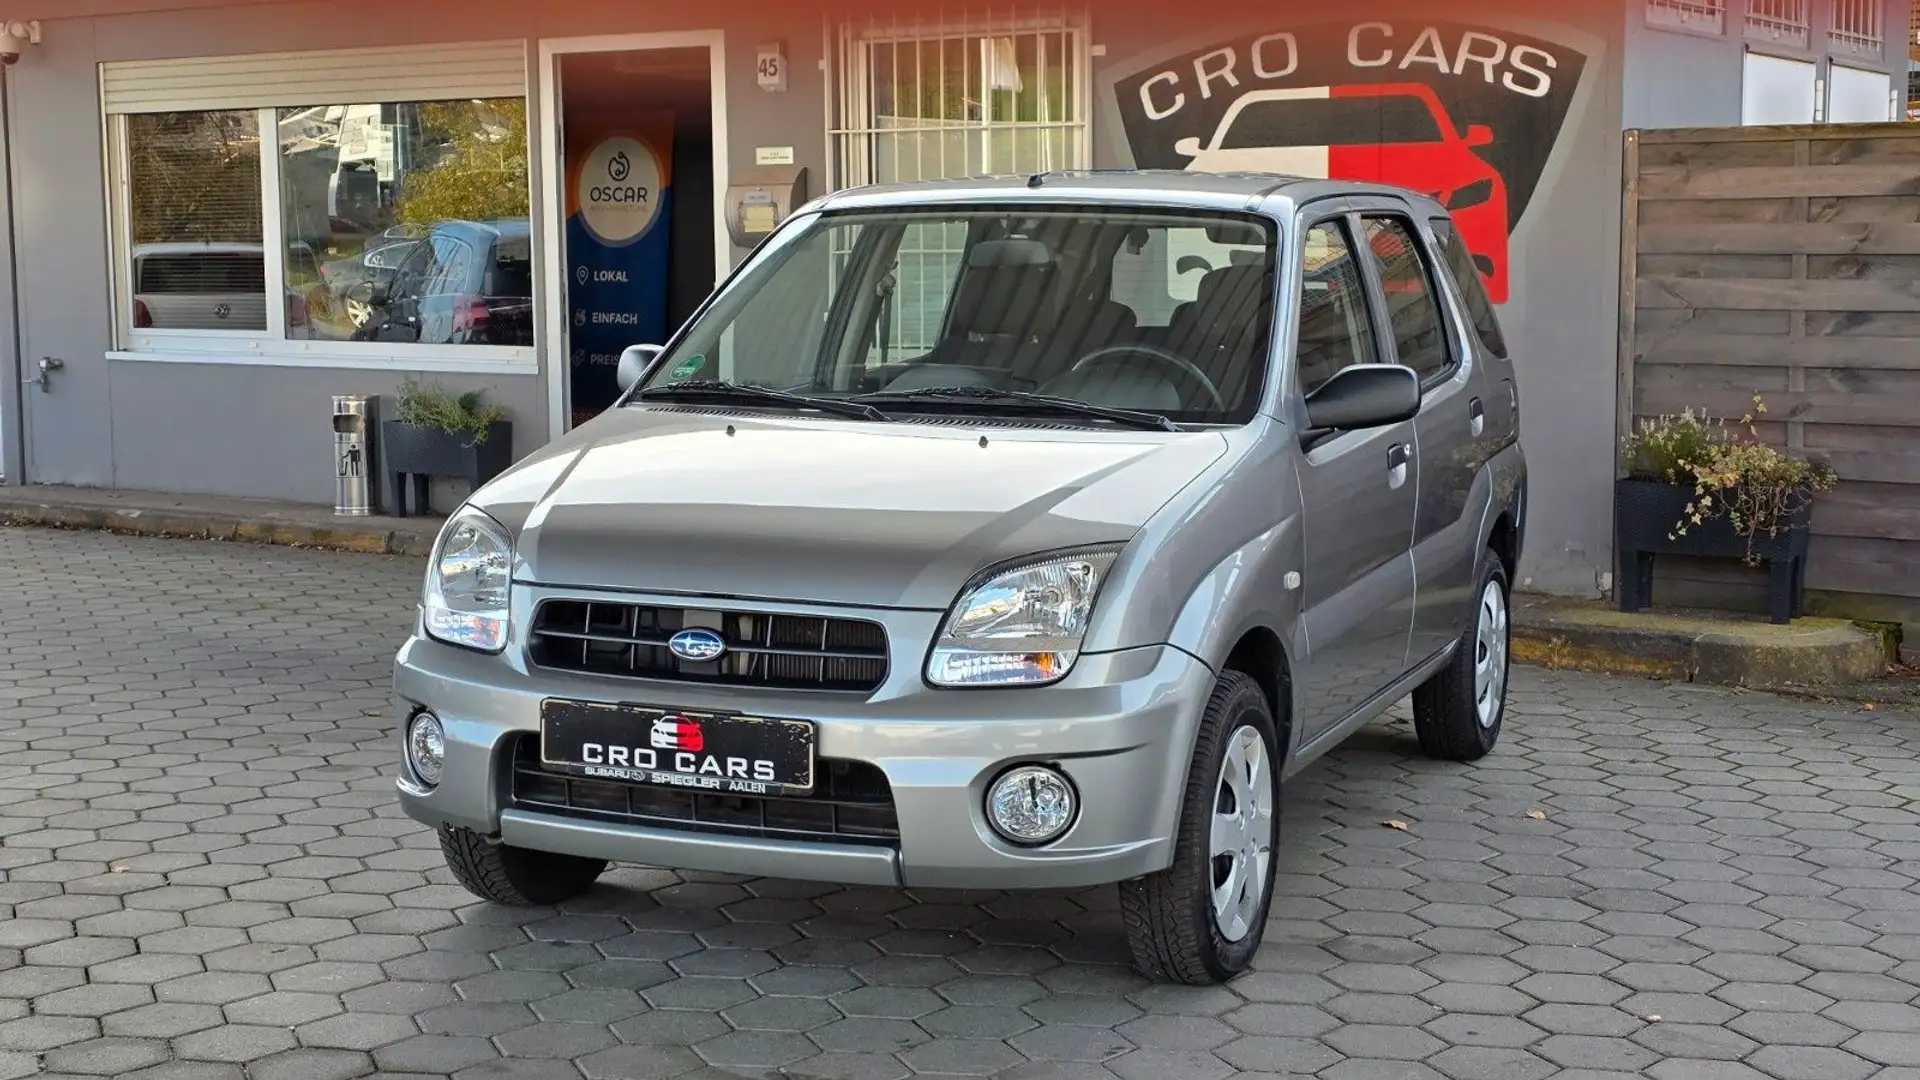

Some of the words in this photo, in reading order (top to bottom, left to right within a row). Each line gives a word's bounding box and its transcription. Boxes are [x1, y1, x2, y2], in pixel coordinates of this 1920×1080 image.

[758, 58, 778, 77] 45
[1138, 32, 1299, 121] CRO
[1347, 21, 1557, 98] CARS
[590, 186, 648, 203] OSCAR
[593, 270, 629, 282] LOKAL
[592, 312, 638, 325] EINFACH
[583, 742, 657, 769] CRO
[675, 752, 775, 781] CARS
[584, 766, 630, 779] SUBARU
[651, 771, 720, 790] SPIEGLER
[728, 780, 766, 794] AALEN
